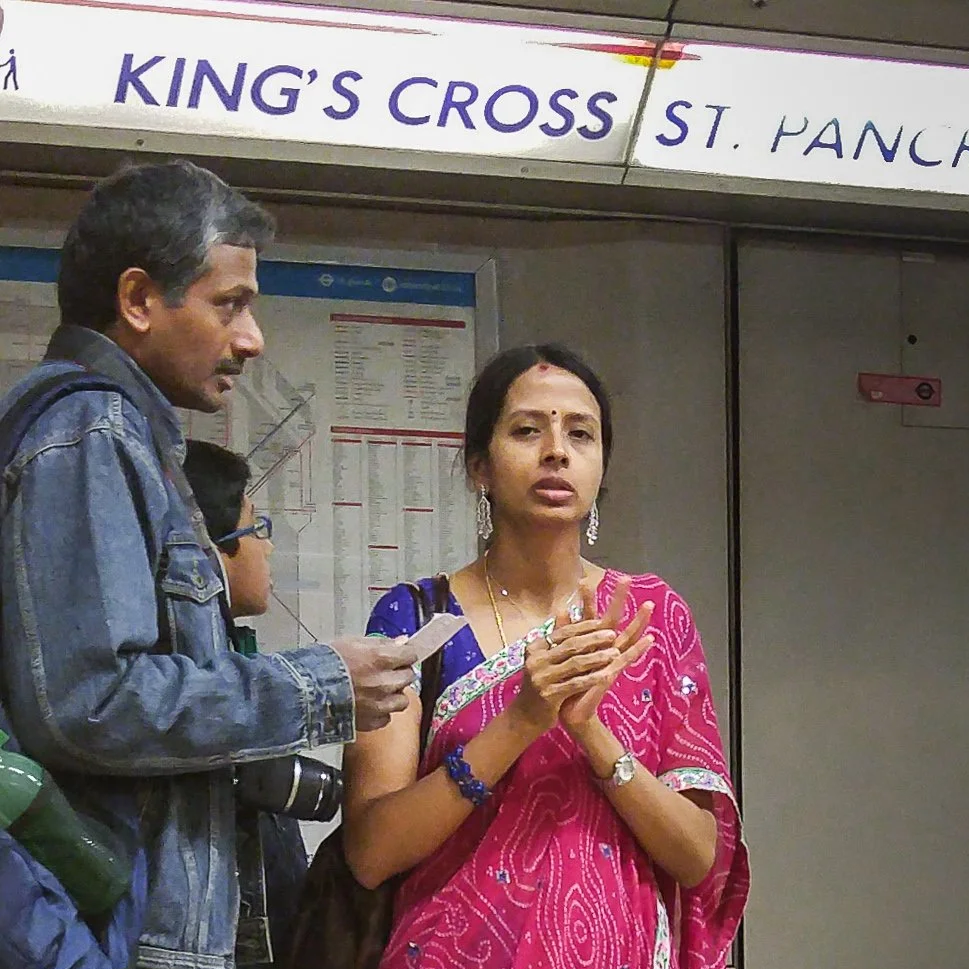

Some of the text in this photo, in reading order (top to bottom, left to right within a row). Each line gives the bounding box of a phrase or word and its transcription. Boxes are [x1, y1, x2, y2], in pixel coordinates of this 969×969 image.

[113, 53, 364, 120] KING'S
[387, 76, 619, 141] CROSS
[655, 100, 740, 150] ST.
